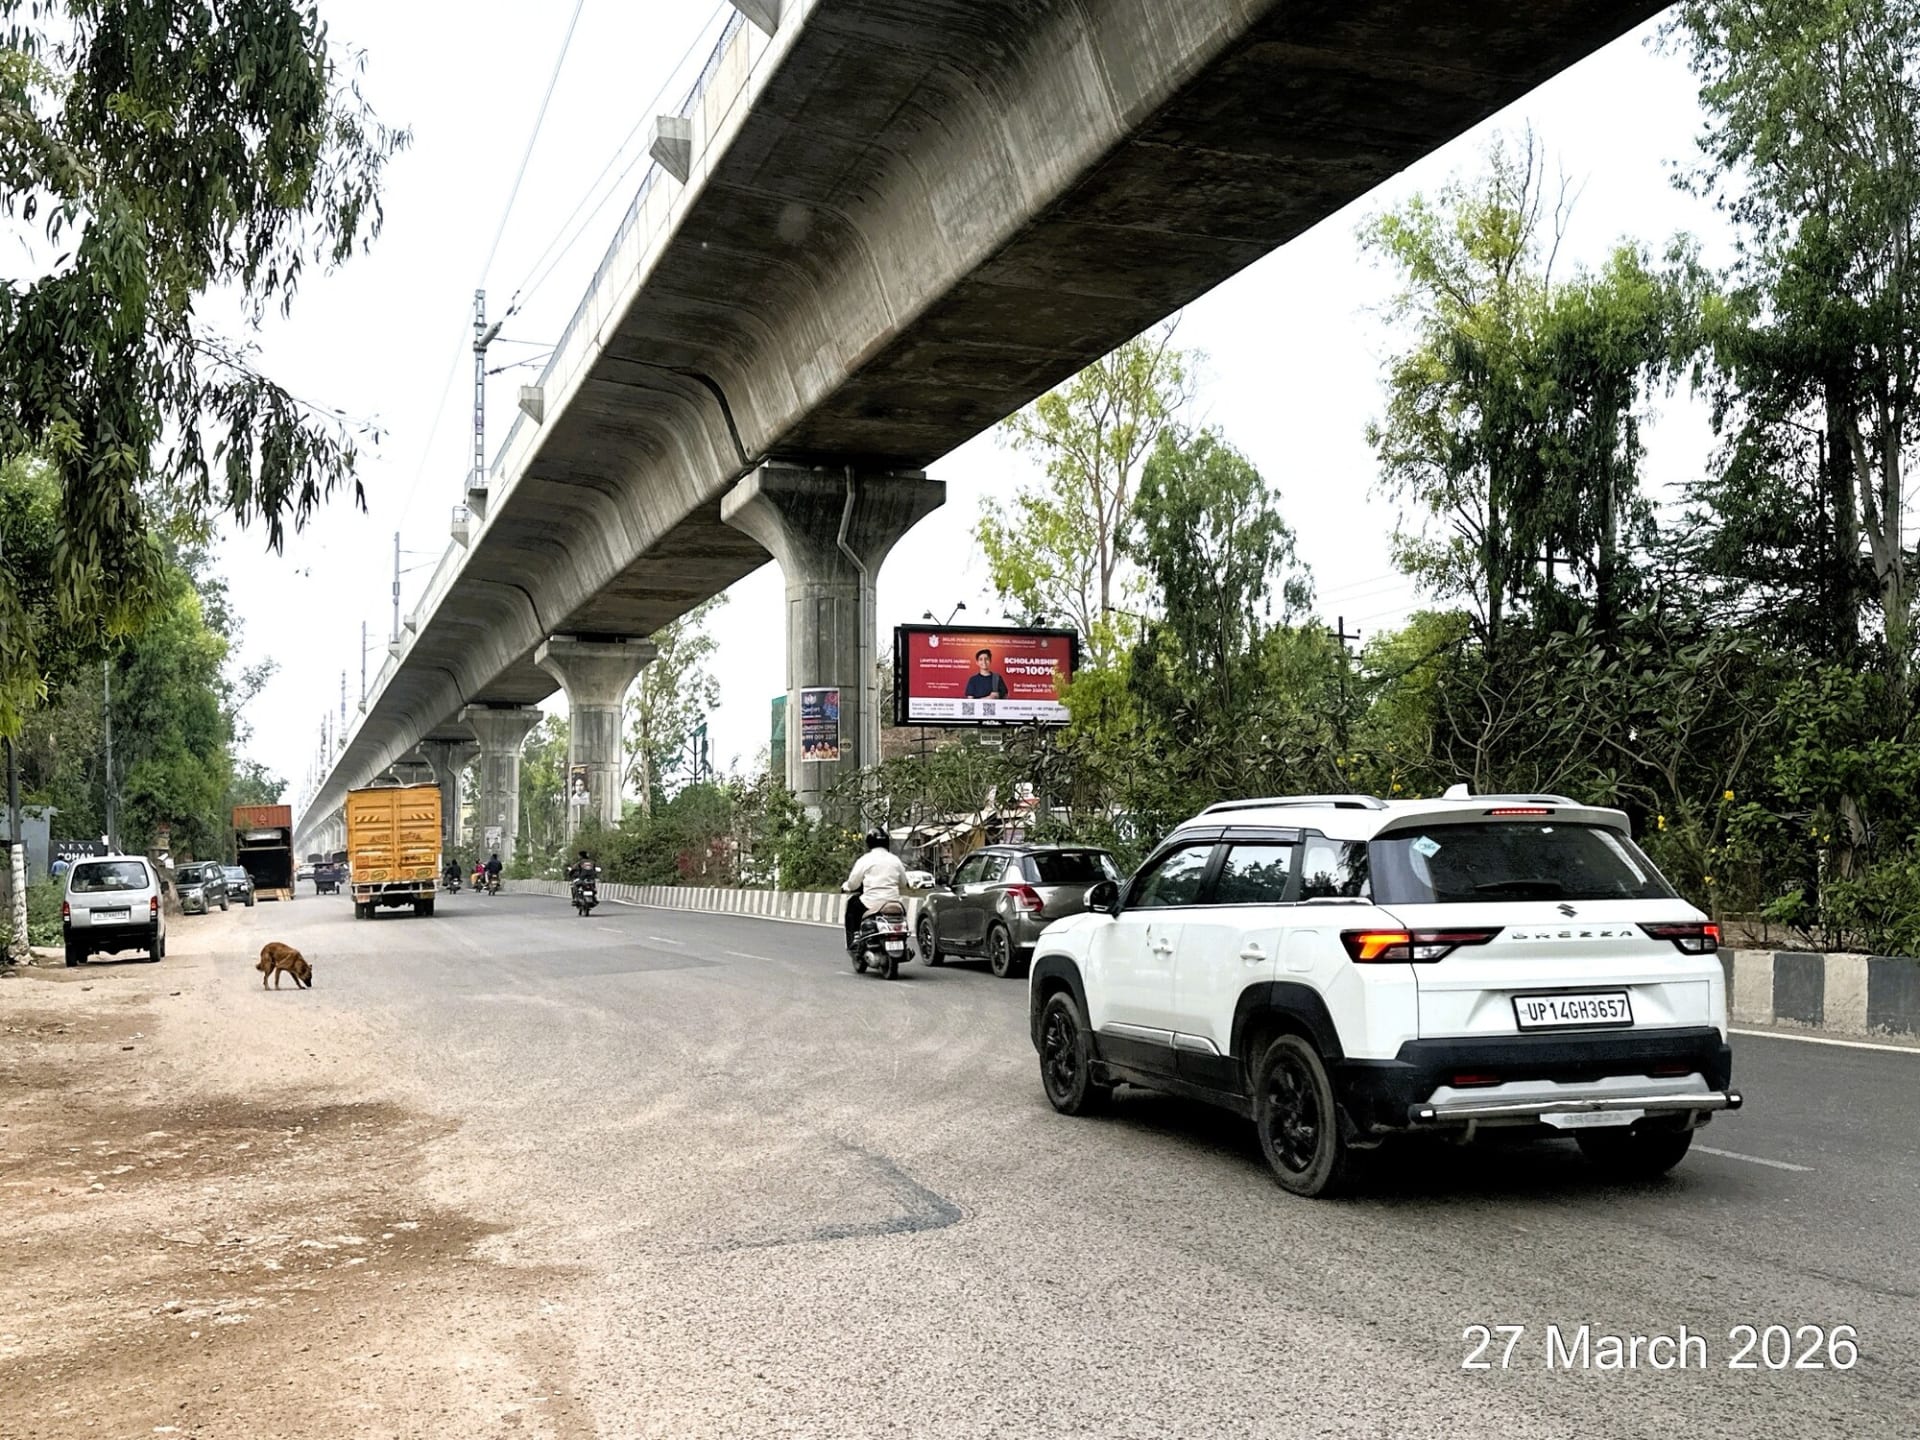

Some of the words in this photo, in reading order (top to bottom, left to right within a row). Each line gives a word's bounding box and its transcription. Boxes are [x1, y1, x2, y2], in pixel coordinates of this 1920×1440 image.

[1026, 666, 1056, 675] 100%
[59, 843, 94, 851] NEXA
[1527, 999, 1626, 1021] UP14GH3657
